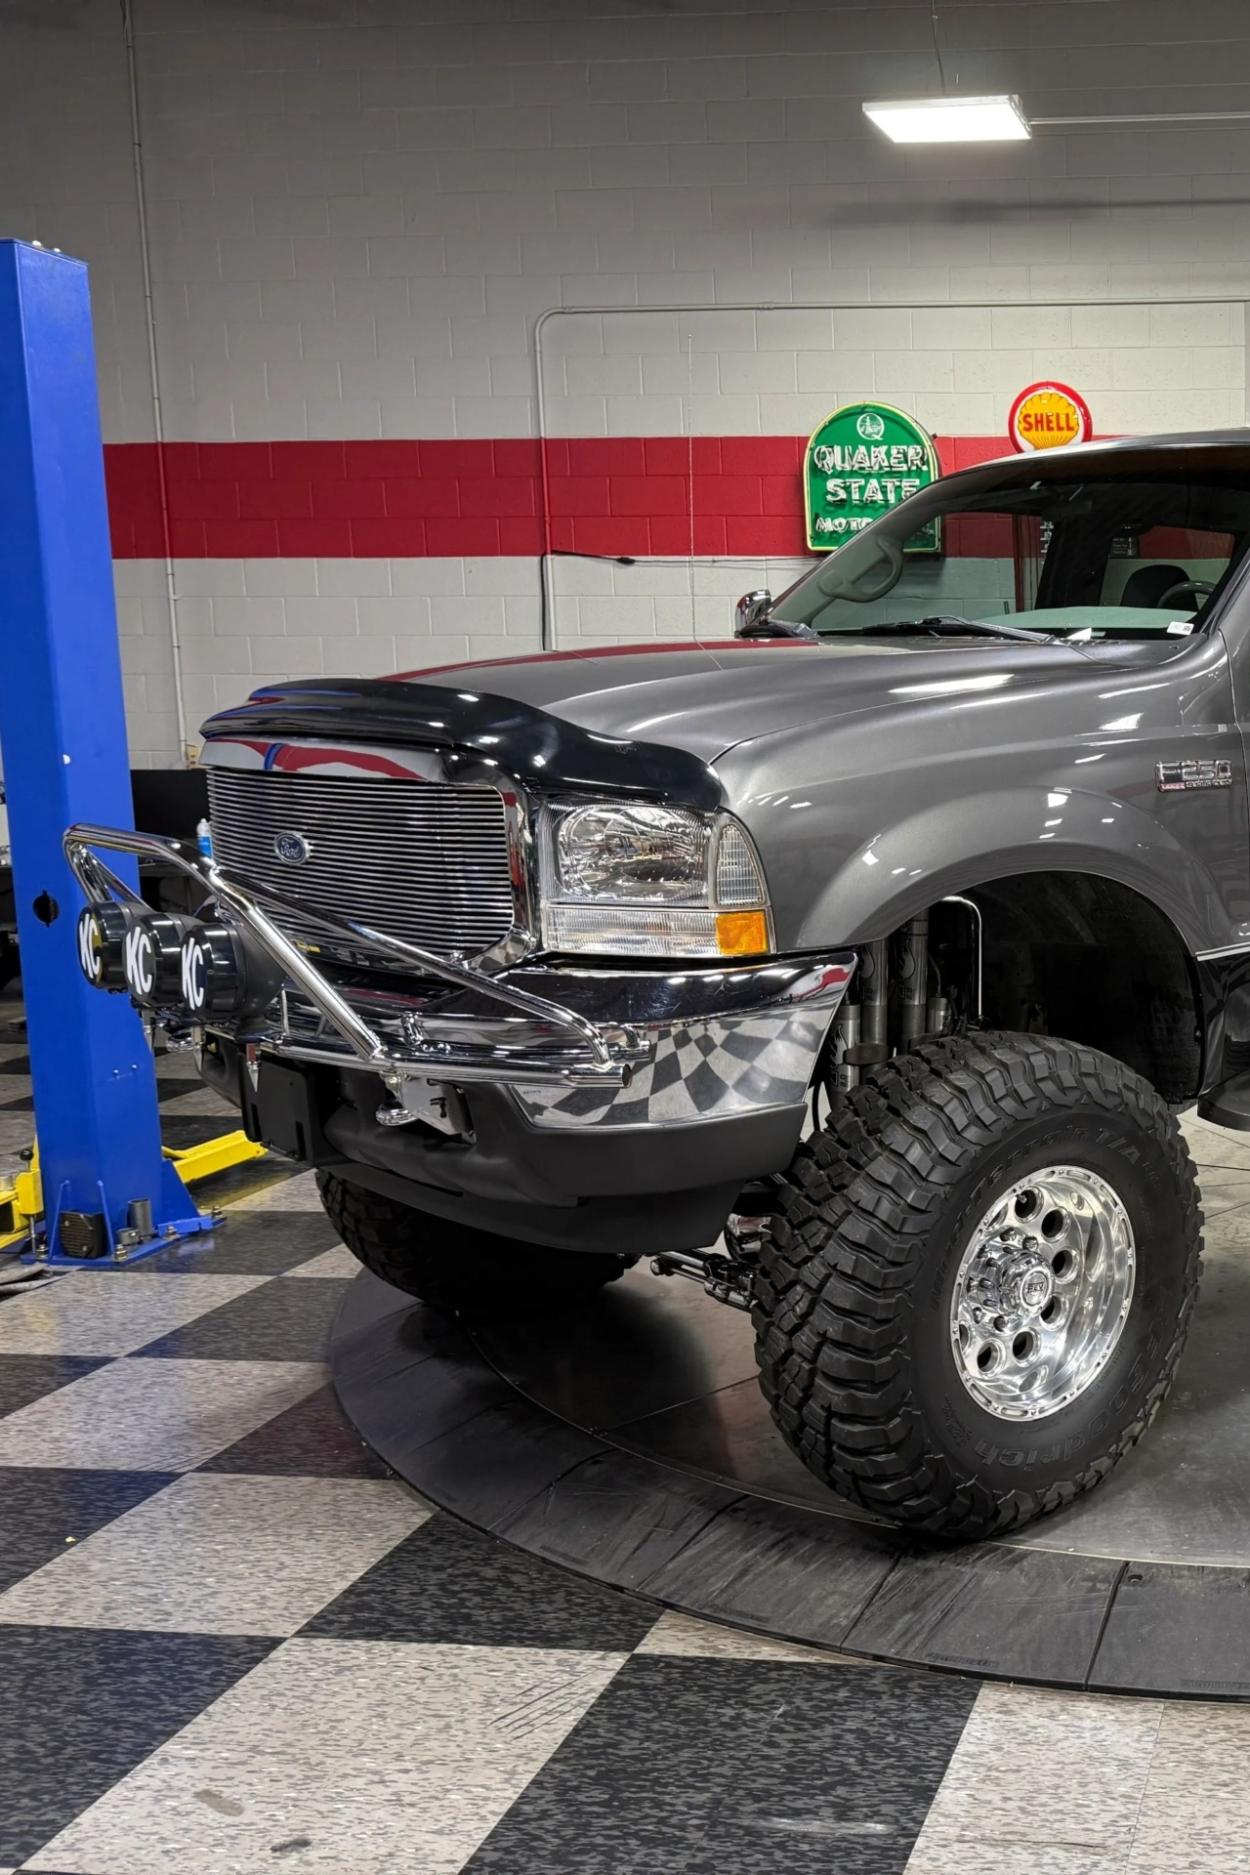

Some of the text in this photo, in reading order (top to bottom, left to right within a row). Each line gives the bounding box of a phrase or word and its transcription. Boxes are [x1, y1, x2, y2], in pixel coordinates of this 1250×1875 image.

[1022, 412, 1076, 432] SHELL
[813, 444, 928, 474] QUAKER
[825, 477, 921, 505] STATE
[79, 913, 101, 979] KC
[126, 926, 153, 995] KC
[182, 937, 204, 1011] KC
